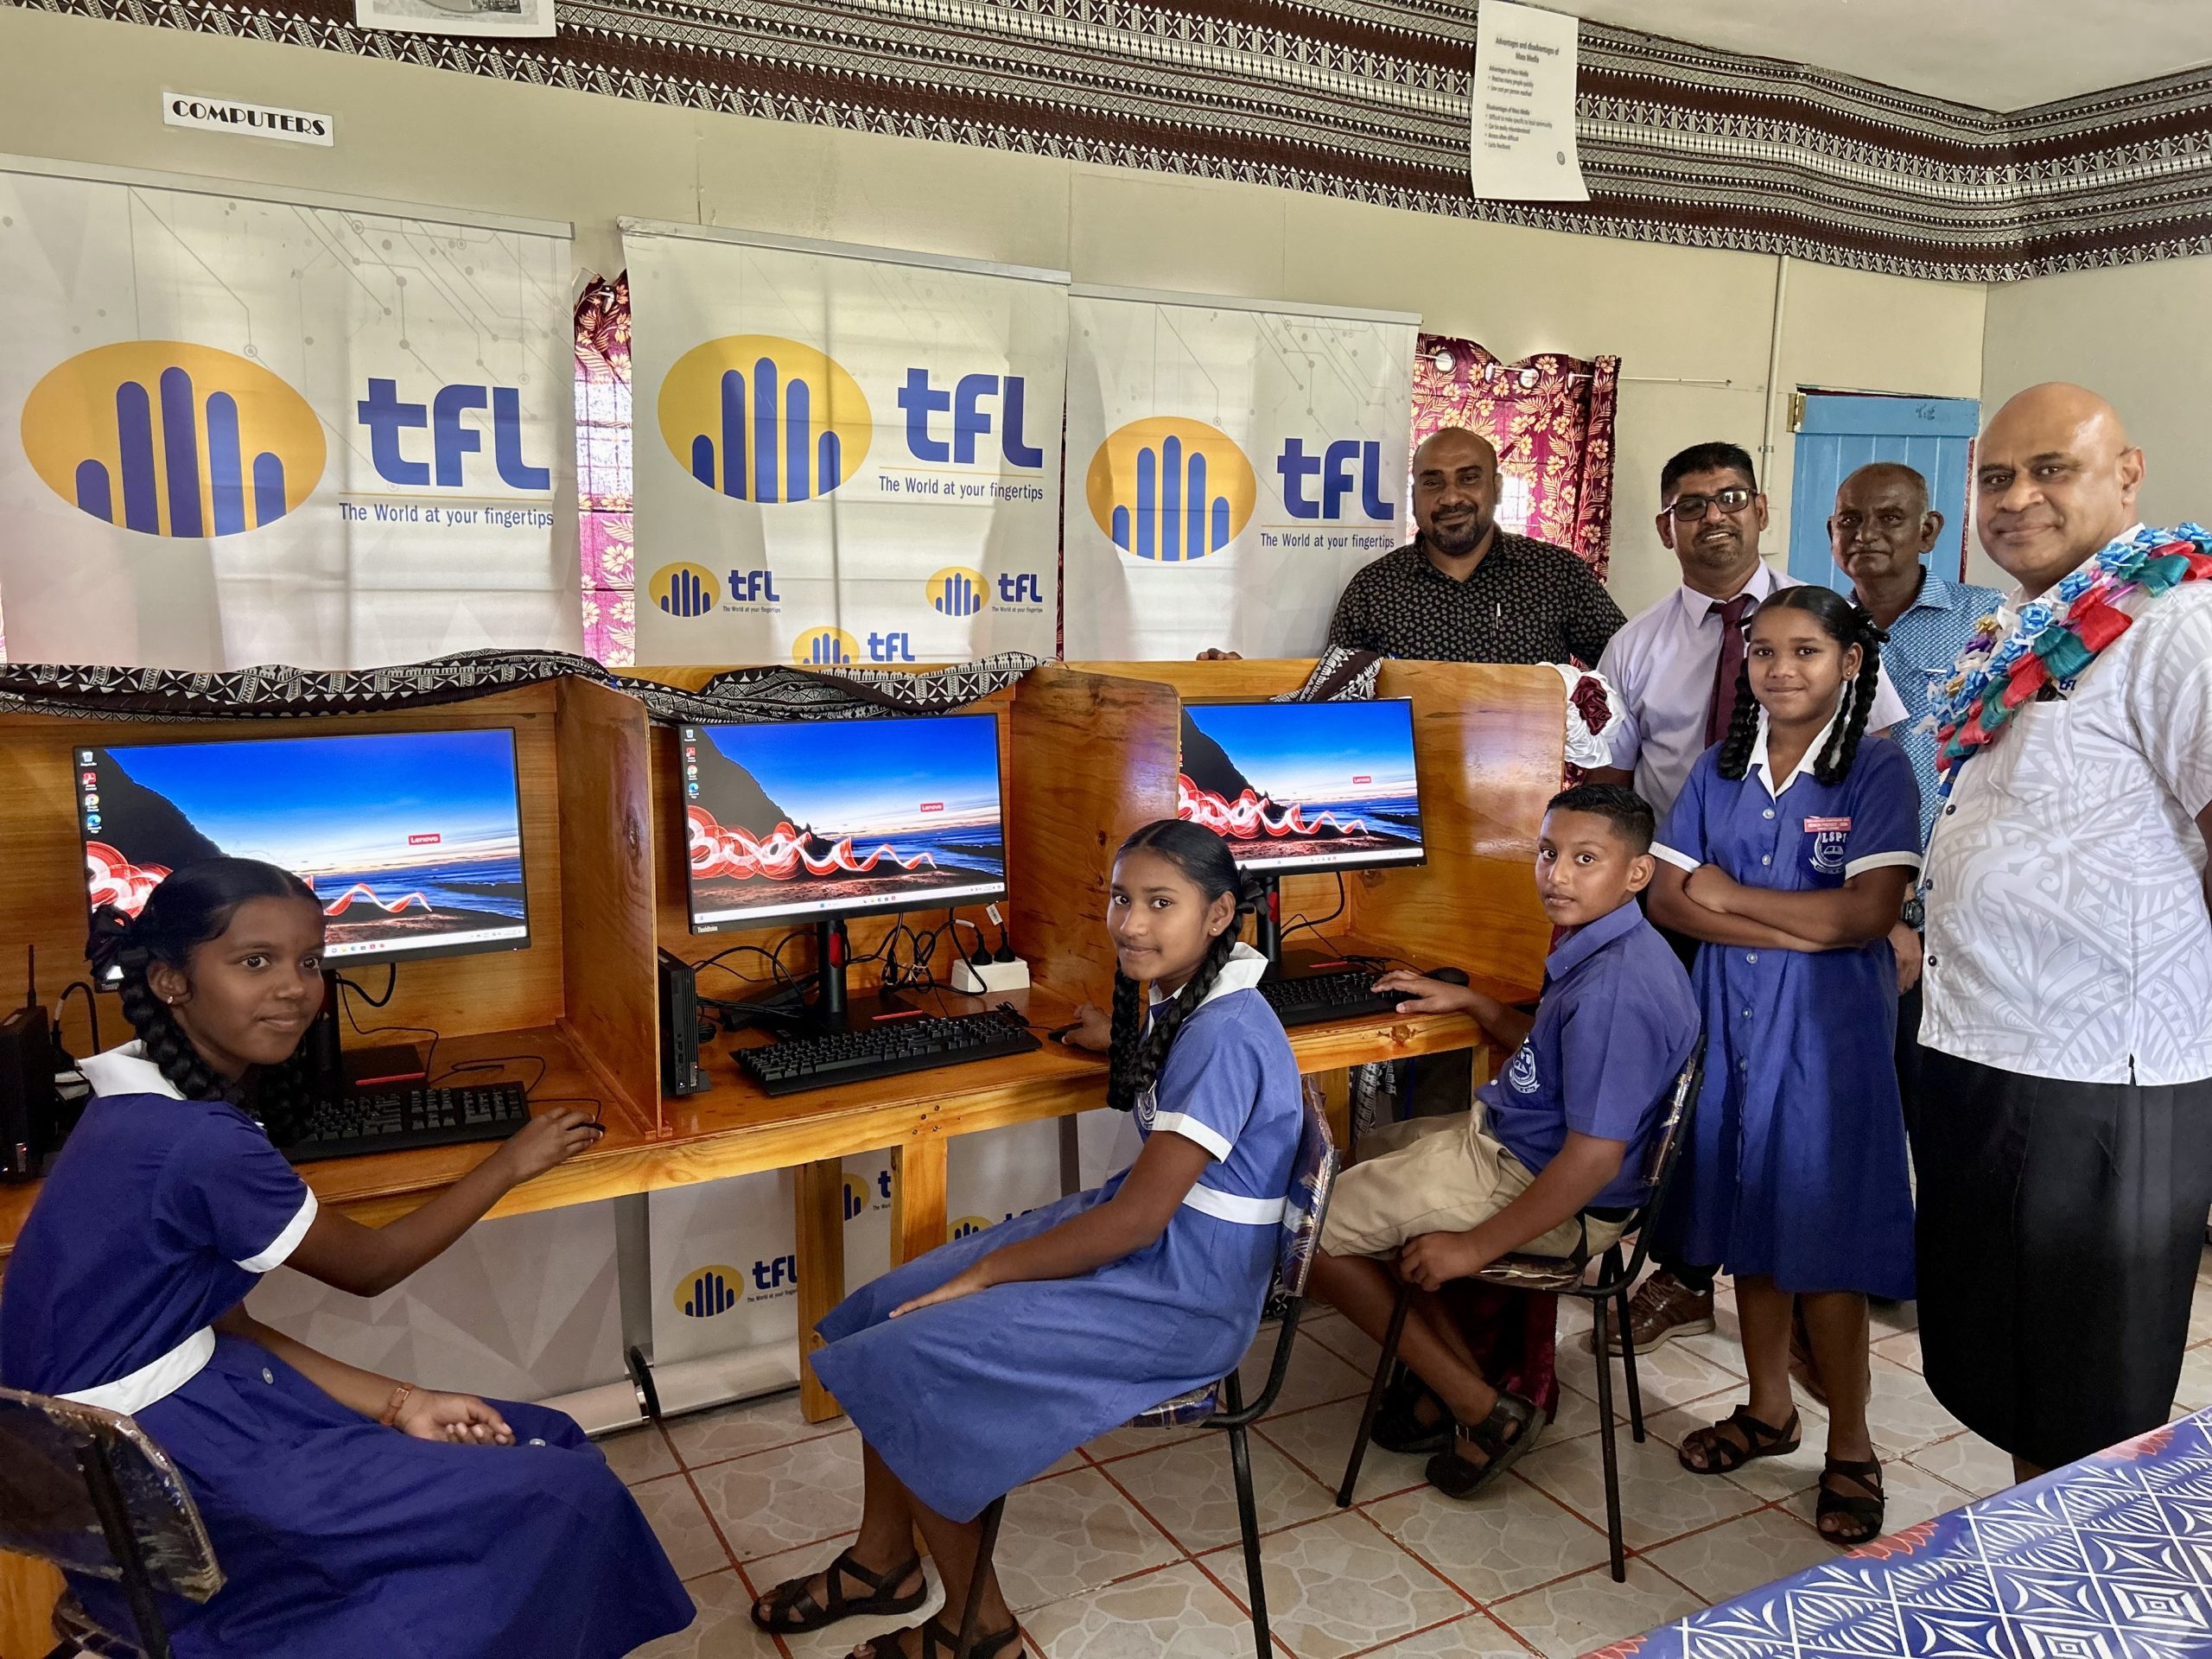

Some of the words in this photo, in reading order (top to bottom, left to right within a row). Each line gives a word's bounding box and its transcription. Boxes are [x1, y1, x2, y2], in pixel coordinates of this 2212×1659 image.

[1527, 54, 1539, 63] Media
[173, 99, 325, 136] COMPUTERS
[879, 476, 900, 492] The
[906, 477, 938, 494] World
[944, 481, 955, 495] at
[960, 485, 985, 499] your
[990, 482, 1043, 502] fingertips
[339, 502, 367, 521] The
[374, 503, 418, 522] World
[425, 507, 440, 523] at
[447, 510, 478, 527] your
[485, 506, 554, 529] fingertips
[1261, 533, 1278, 547] The
[1282, 533, 1310, 547] World
[1314, 535, 1324, 547] at
[1327, 537, 1348, 550] your
[1352, 534, 1395, 550] fingertips
